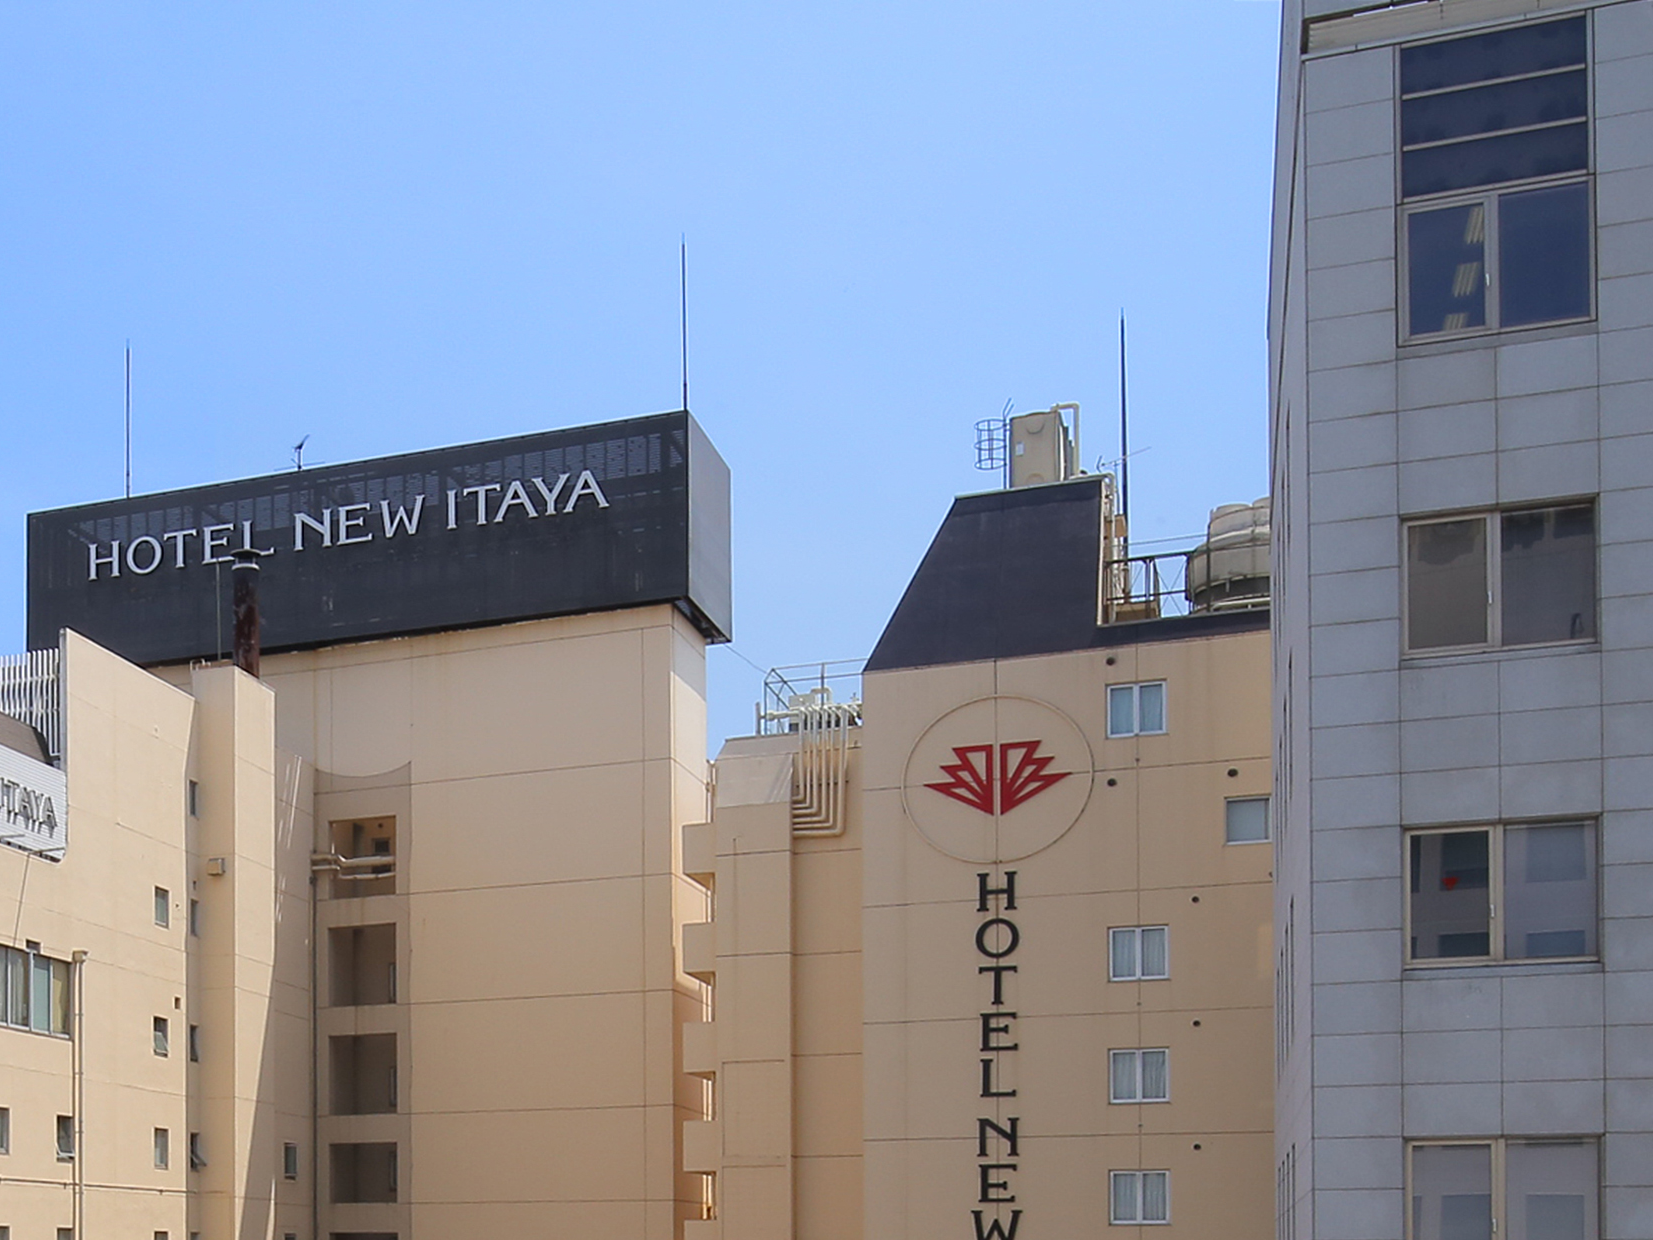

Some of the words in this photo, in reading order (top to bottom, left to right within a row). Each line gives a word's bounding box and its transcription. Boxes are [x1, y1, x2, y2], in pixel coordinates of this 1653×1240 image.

[87, 520, 275, 581] HOTEL
[292, 494, 425, 551] NEW
[446, 468, 610, 531] ITAYA
[975, 870, 1020, 1098] HOTEL
